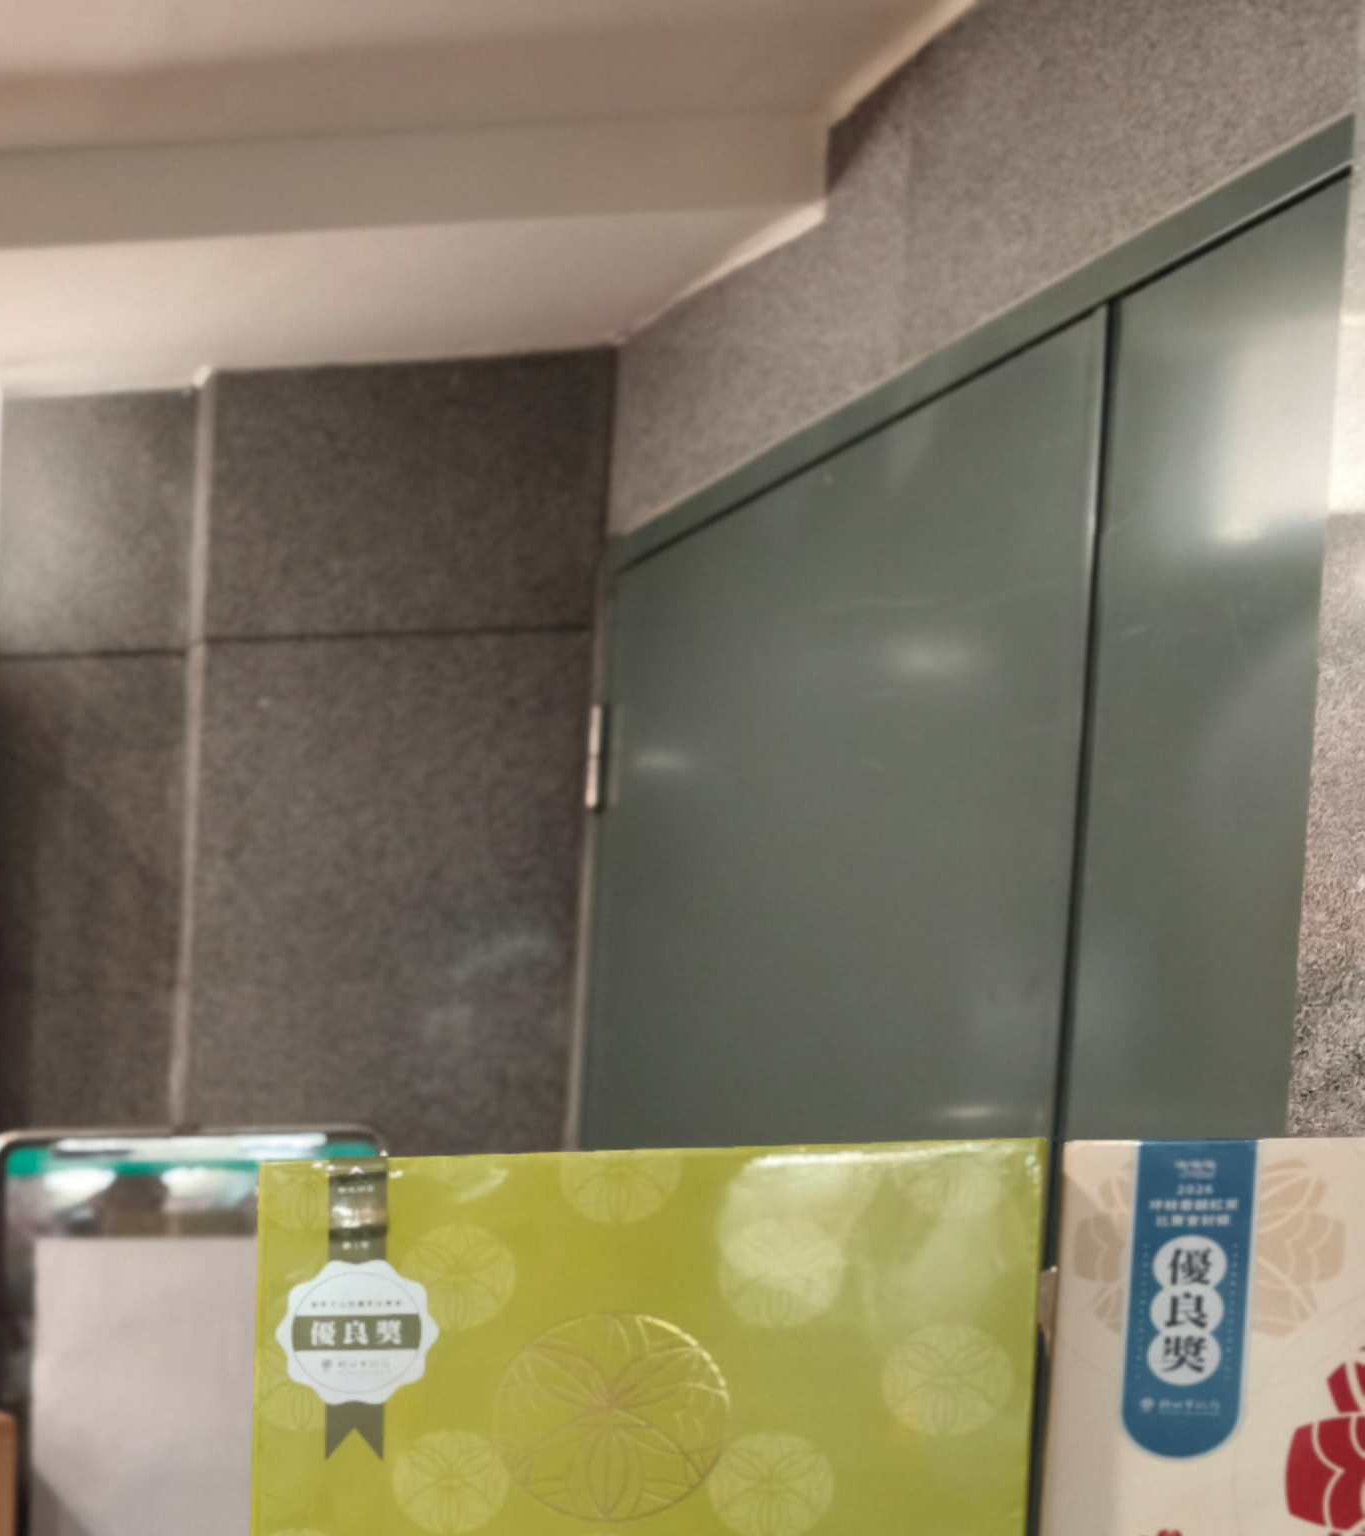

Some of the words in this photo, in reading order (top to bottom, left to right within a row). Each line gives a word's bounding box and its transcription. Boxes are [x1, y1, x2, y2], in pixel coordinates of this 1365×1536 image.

[311, 1320, 402, 1346] 優良獎
[1163, 1248, 1212, 1374] 優良獎
